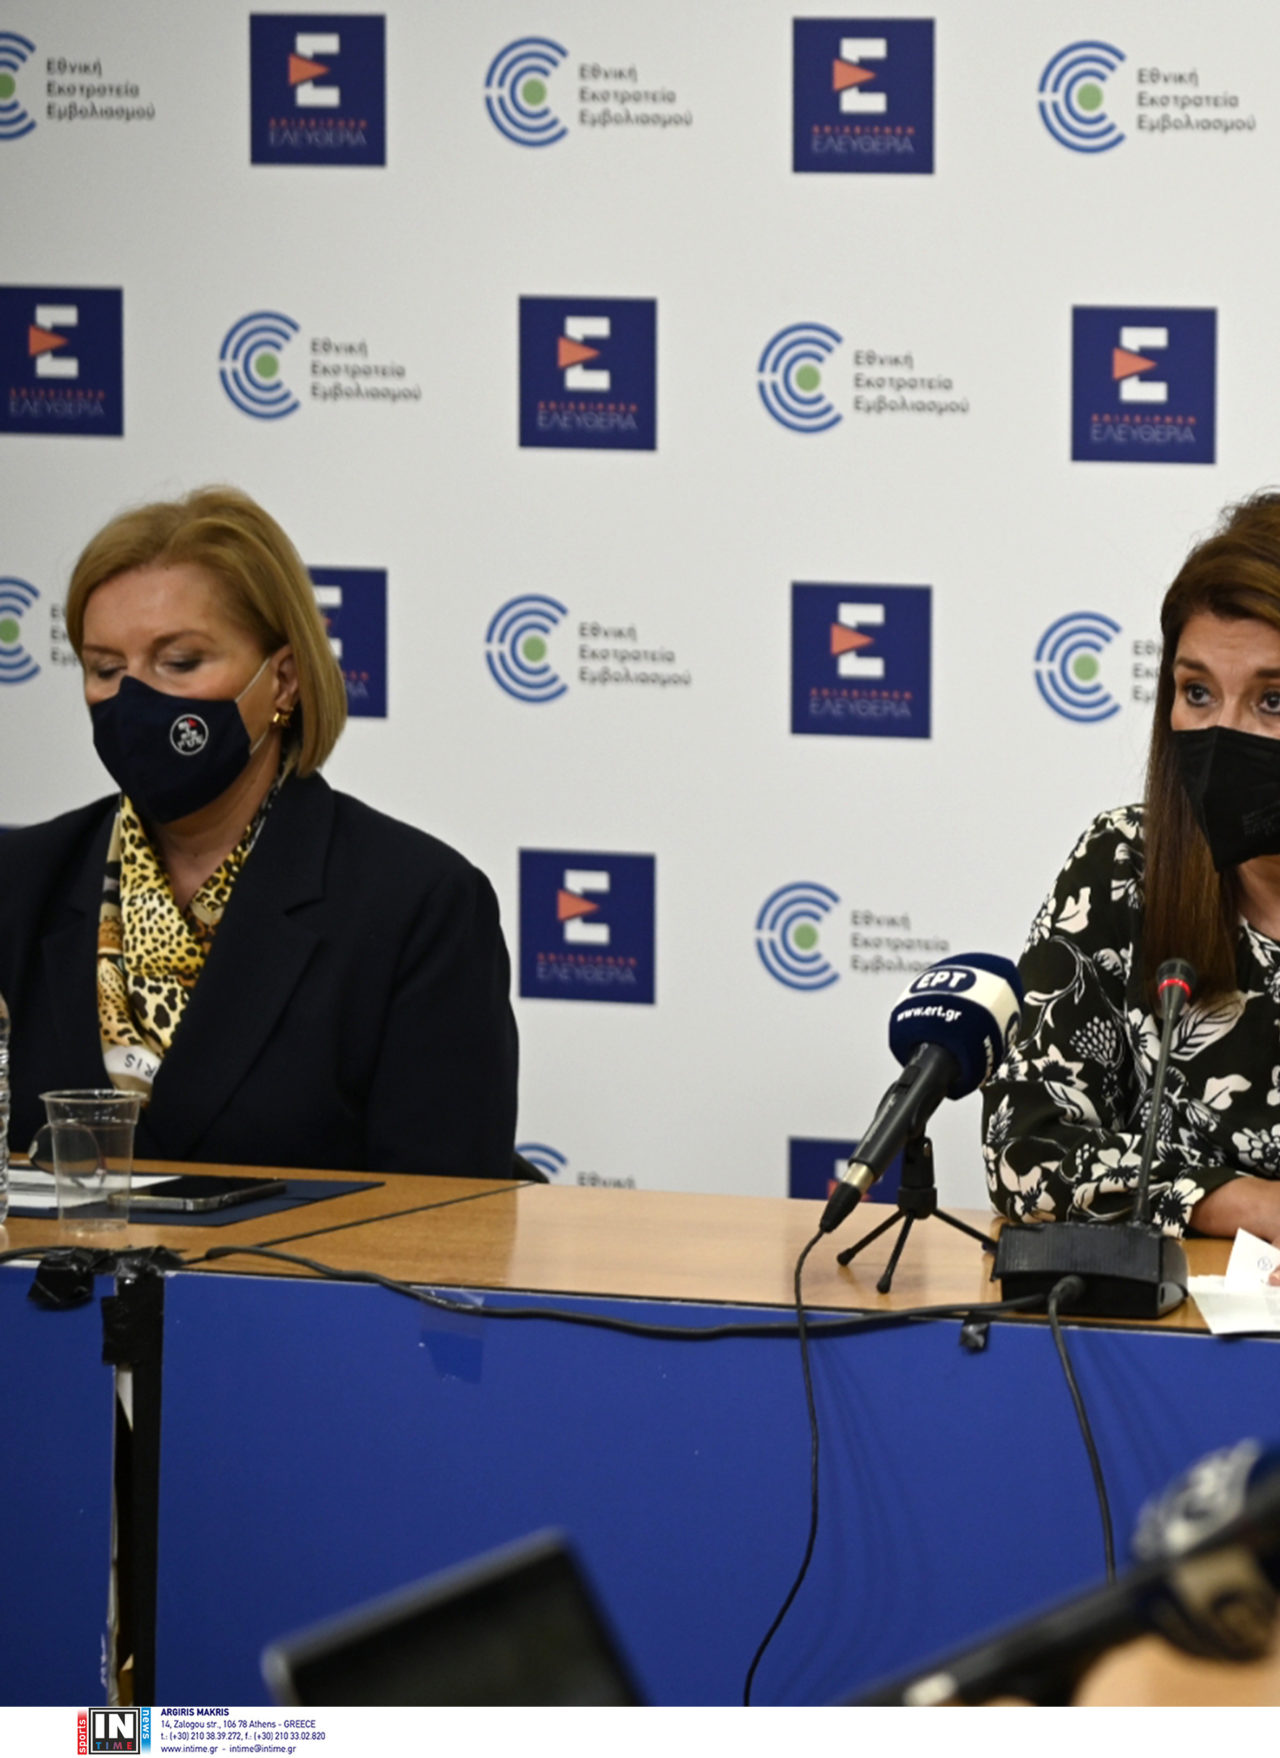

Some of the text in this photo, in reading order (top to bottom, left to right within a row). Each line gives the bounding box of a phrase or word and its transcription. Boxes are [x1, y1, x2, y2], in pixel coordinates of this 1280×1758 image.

[1136, 68, 1199, 88] Εθνική
[1136, 91, 1239, 111] Εκστρατεία
[1136, 114, 1256, 134] Εμβολιασμού
[852, 350, 914, 371] Εθνική
[852, 373, 953, 393] Εκστρατεία
[852, 395, 970, 416] Εμβολιασμού
[915, 970, 968, 990] ΕΡΤ
[897, 1005, 962, 1022] www.ert.gr
